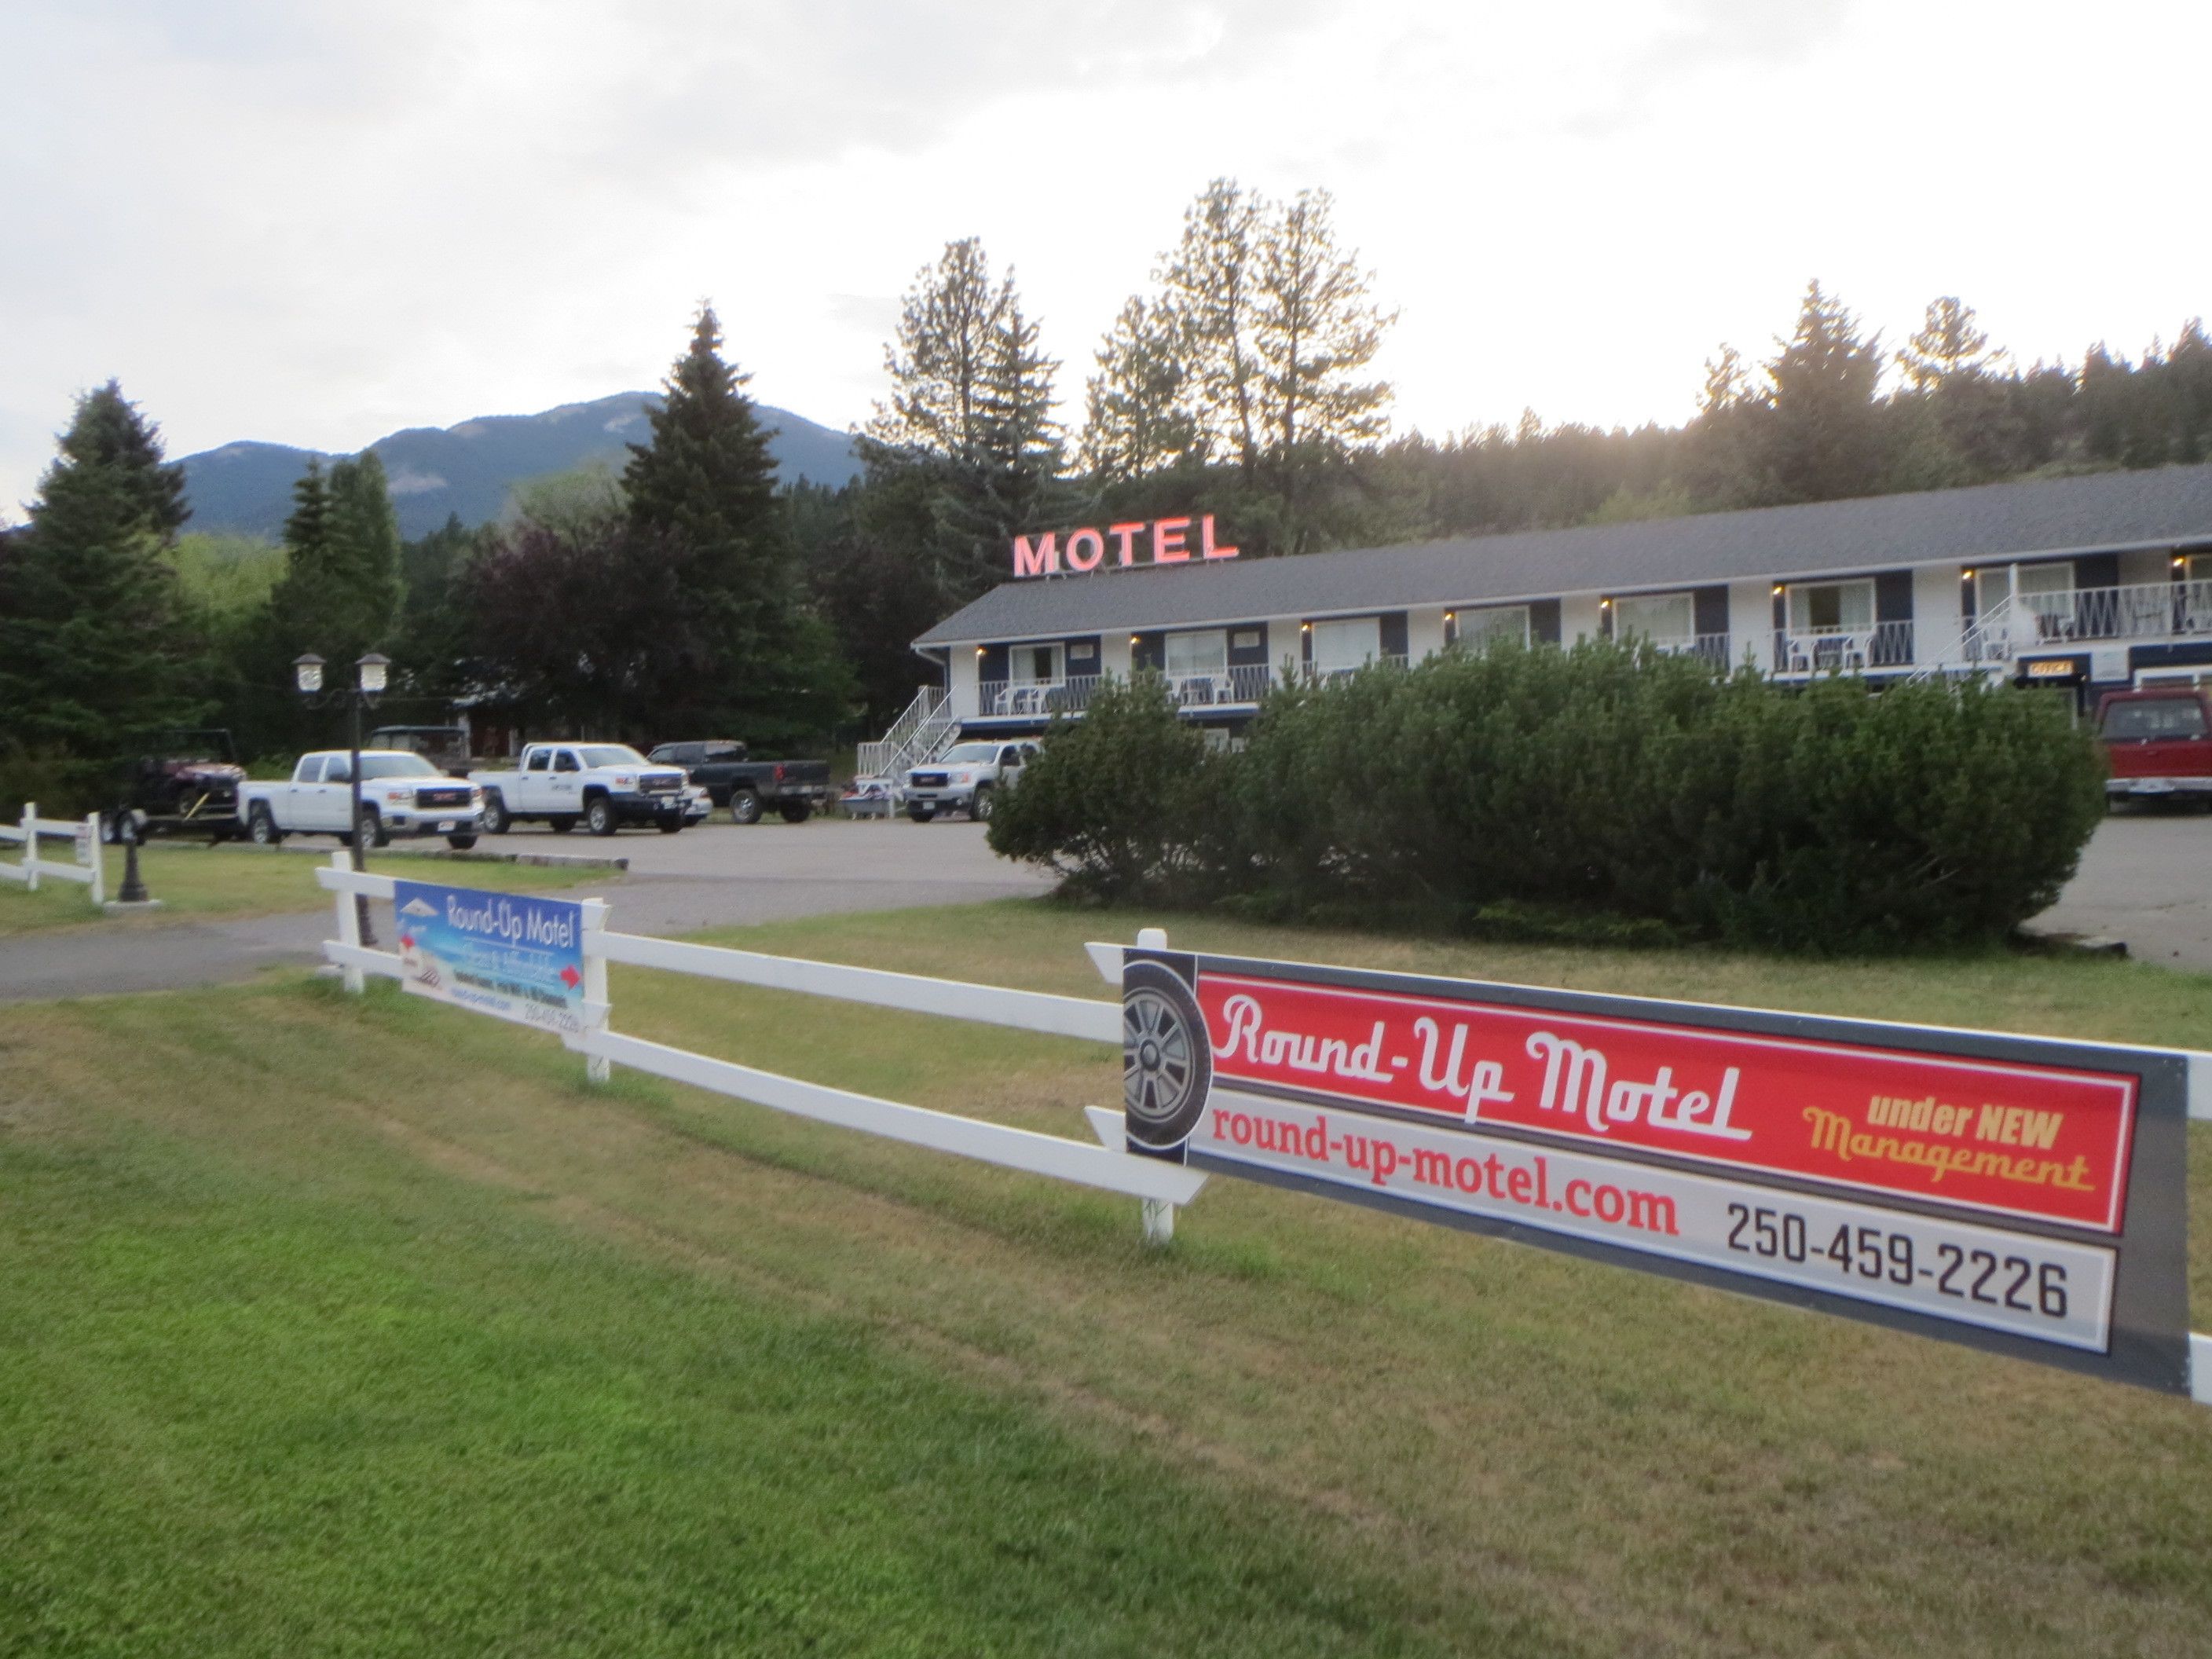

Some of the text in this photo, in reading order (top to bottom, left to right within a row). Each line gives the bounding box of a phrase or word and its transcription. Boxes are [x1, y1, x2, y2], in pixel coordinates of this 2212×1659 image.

[1013, 514, 1240, 577] MOTEL
[446, 895, 574, 948] Round-Up Motel
[1213, 994, 1752, 1141] Round-Up Motel
[1802, 1105, 2095, 1192] Management
[1867, 1095, 2064, 1150] under NEW
[1213, 1108, 1680, 1236] round-up-motel.com
[1727, 1203, 2067, 1318] 250-459-2226
